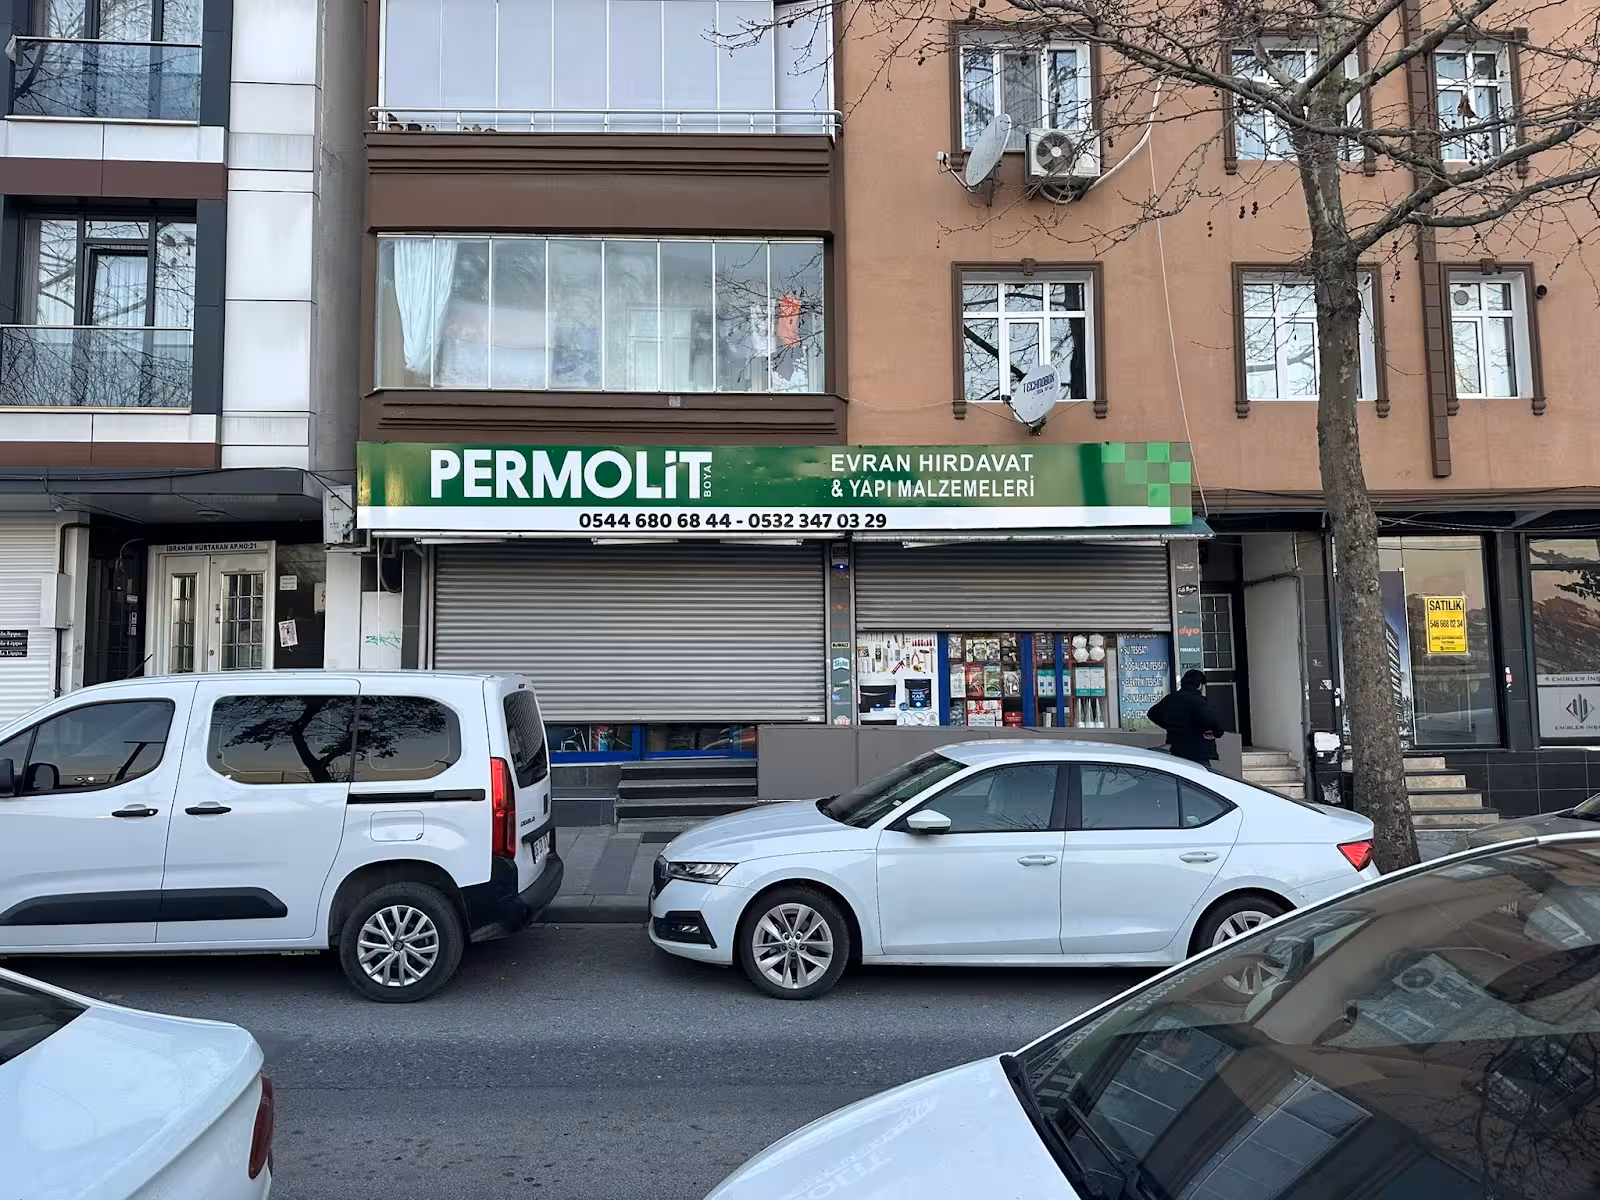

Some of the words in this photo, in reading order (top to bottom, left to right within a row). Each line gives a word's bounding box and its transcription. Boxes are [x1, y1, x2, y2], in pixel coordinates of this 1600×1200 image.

[831, 454, 911, 472] EVRAN
[919, 454, 1033, 472] HIRDAVAT
[703, 464, 712, 498] BOYA
[831, 479, 844, 498] &
[849, 479, 892, 498] YAPI
[898, 475, 1034, 498] MALZEMELERİ
[579, 513, 631, 528] 0544
[635, 513, 672, 528] 680
[677, 513, 700, 528] 68
[705, 513, 732, 528] 44
[749, 513, 794, 528] 0532
[799, 513, 832, 528] 347
[837, 513, 860, 528] 03
[864, 513, 887, 528] 29
[195, 543, 228, 552] KURTARAN
[1429, 600, 1462, 611] SATILIK
[1179, 626, 1200, 637] dyo
